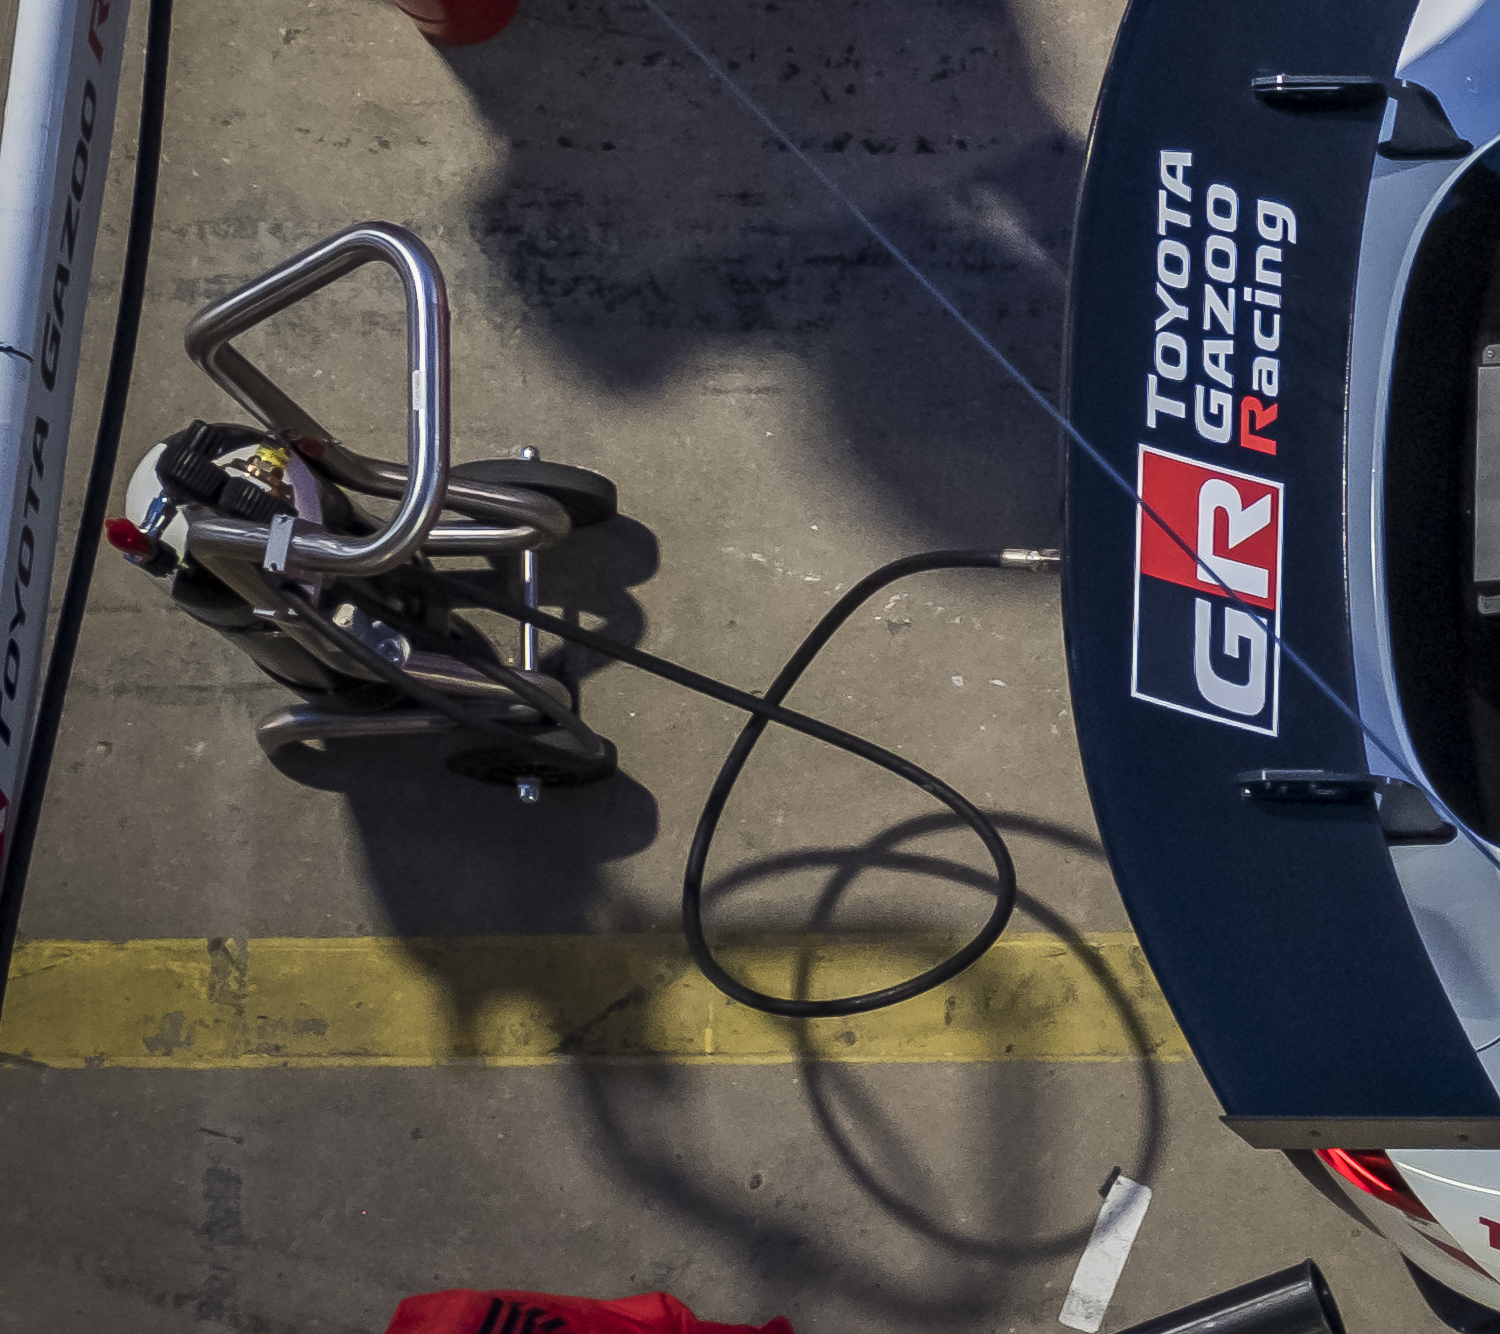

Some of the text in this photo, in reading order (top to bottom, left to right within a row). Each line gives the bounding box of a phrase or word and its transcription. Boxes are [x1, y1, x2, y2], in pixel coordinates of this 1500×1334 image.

[0, 415, 50, 749] TOYOTA
[41, 78, 97, 392] GAZOO
[1146, 149, 1193, 429] TOYOTA
[1195, 183, 1240, 444] GAZOO
[1239, 197, 1297, 455] Racing
[1193, 477, 1274, 716] GR
